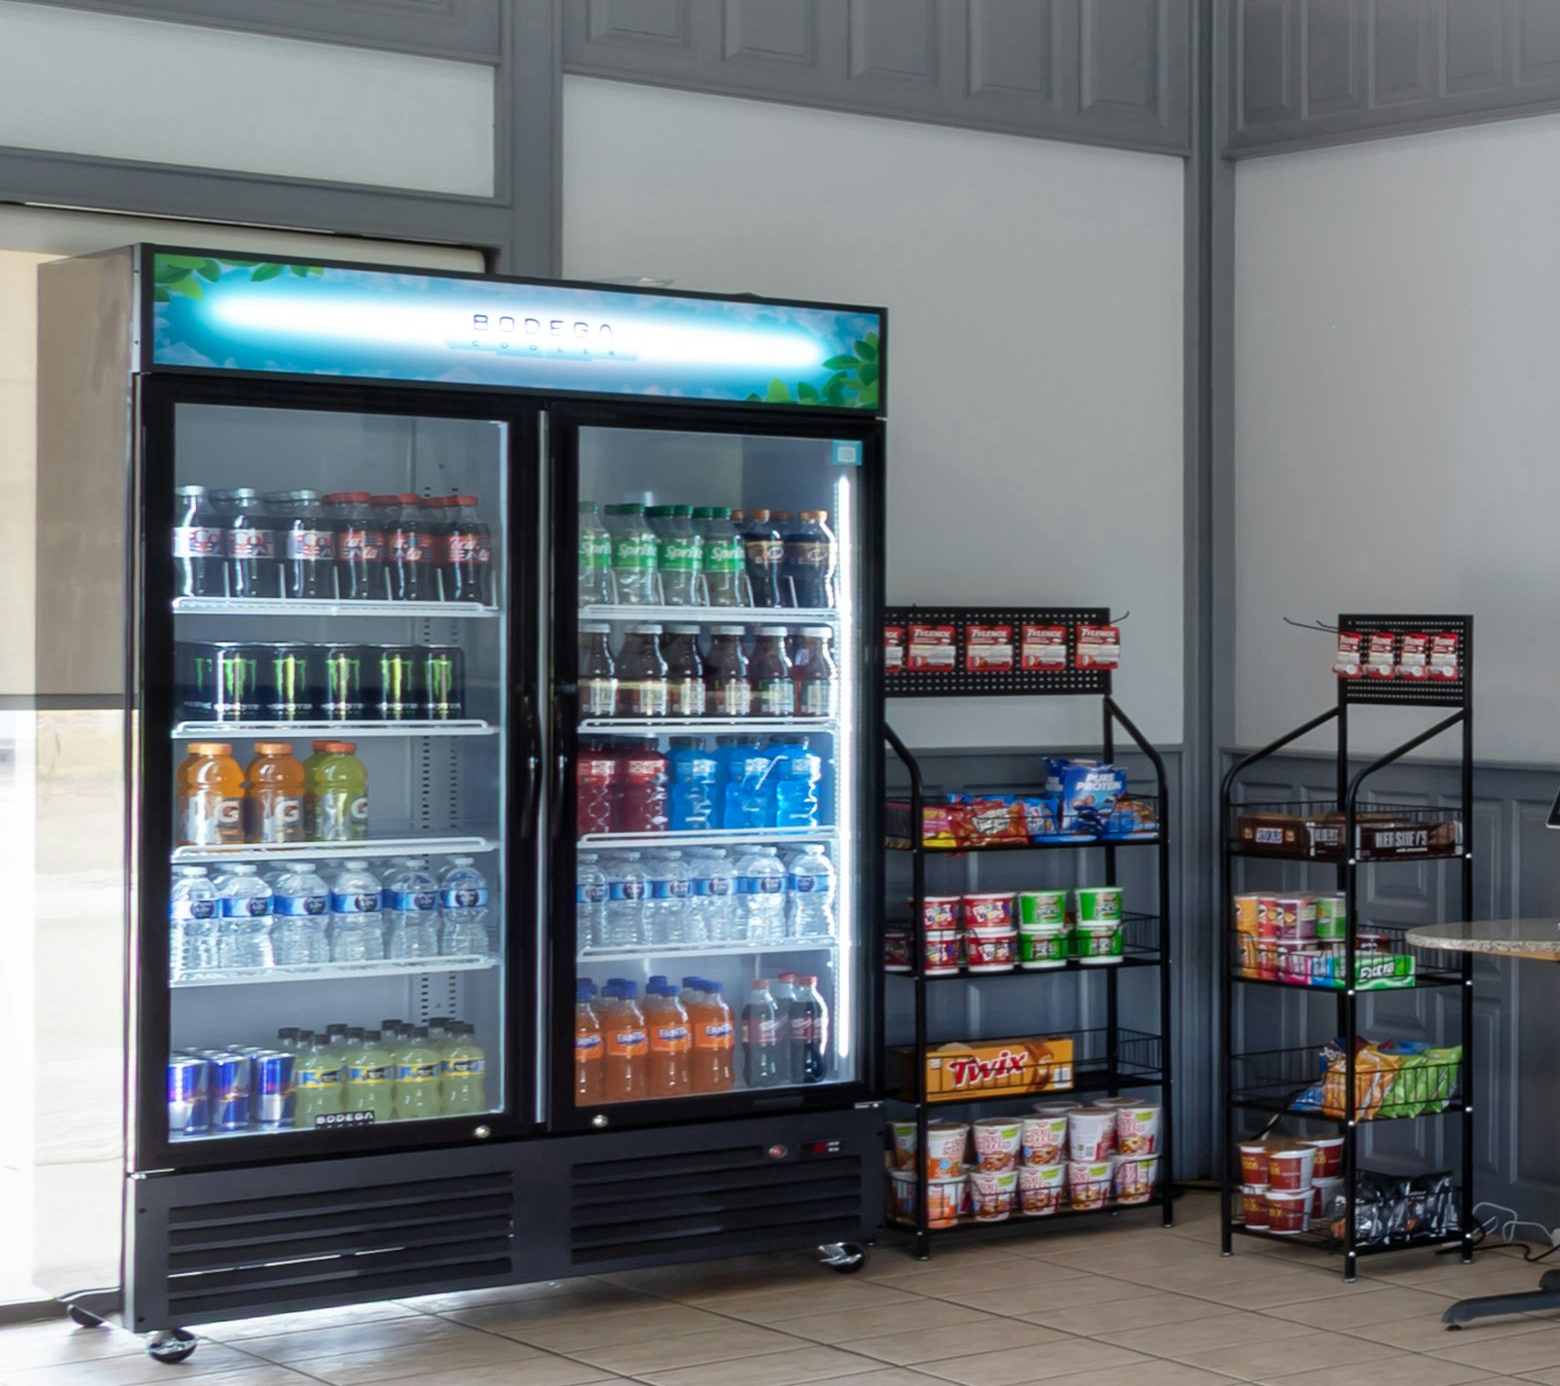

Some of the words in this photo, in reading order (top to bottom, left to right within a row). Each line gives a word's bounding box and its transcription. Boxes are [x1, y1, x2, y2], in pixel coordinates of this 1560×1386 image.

[473, 313, 613, 340] BODEGA
[1075, 781, 1122, 791] PROTEIN
[1085, 772, 1115, 782] PURE
[948, 1050, 1029, 1088] Twix
